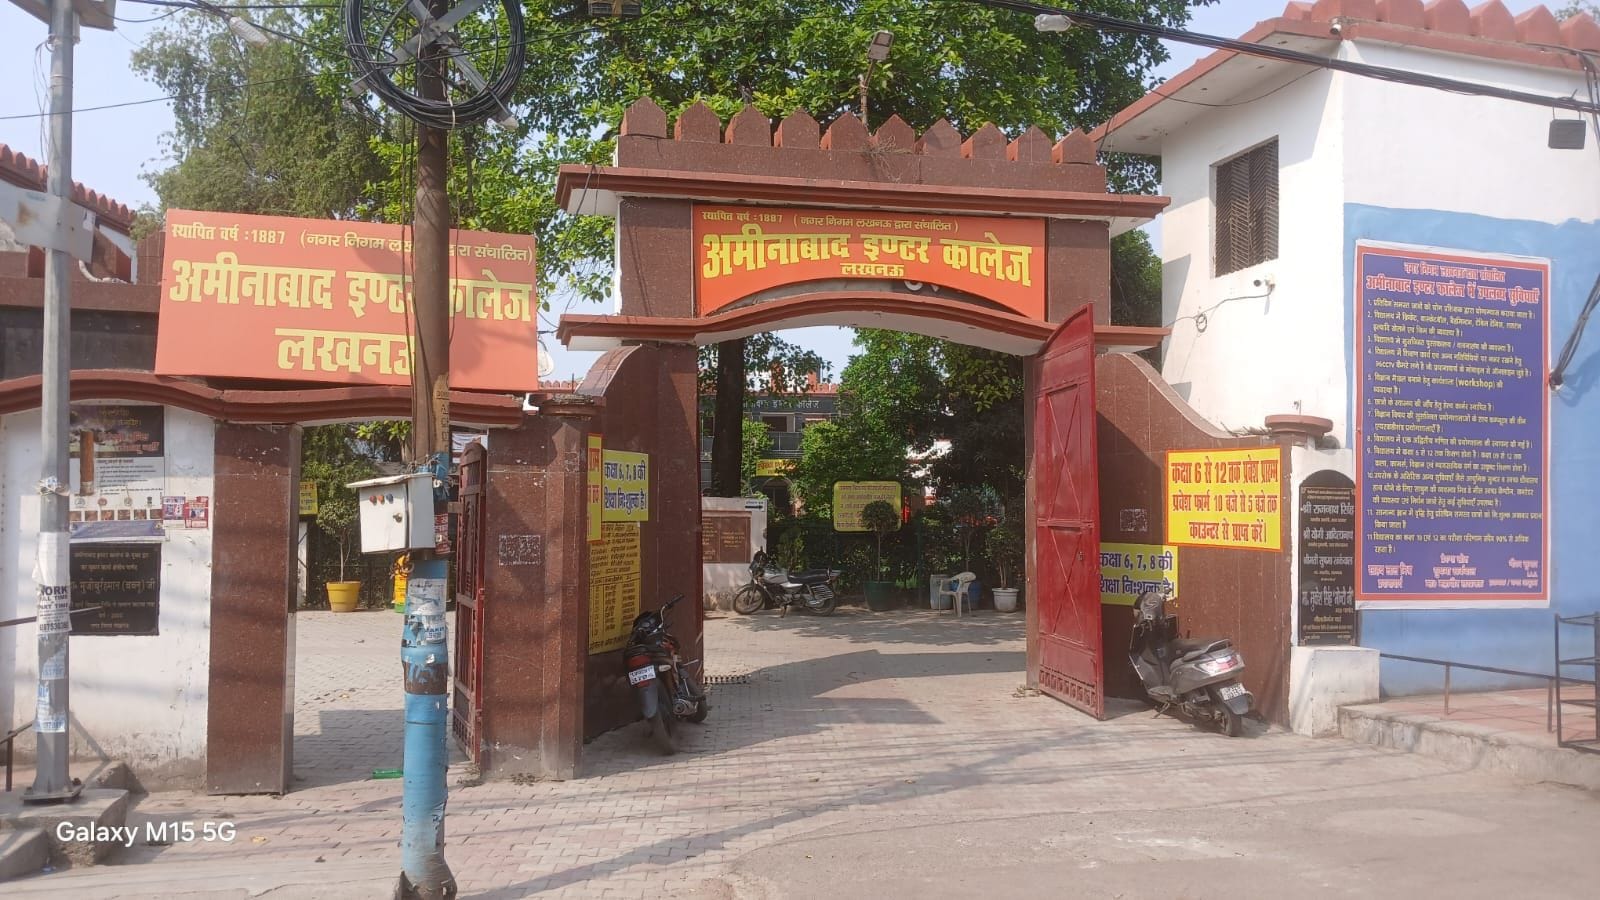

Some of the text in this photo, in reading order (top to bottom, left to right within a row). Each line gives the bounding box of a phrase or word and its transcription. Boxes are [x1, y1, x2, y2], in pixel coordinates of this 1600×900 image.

[702, 210, 732, 222] स्थापित
[736, 211, 750, 223] वर्ष
[826, 214, 854, 227] निगम
[855, 218, 892, 229] लखनऊ
[894, 218, 912, 232] द्वारा
[914, 218, 953, 232] संचालित
[171, 222, 216, 240] स्थापित
[220, 224, 240, 242] वर्ष
[344, 232, 385, 249] निगम
[702, 224, 1032, 286] अमीनाबाद इण्टर कालेज
[840, 262, 904, 277] लखनऊ
[169, 251, 336, 310] अमीनाबाद
[345, 270, 414, 318] इण्ट
[1366, 274, 1411, 292] अमीनाबाद
[1413, 279, 1434, 296] इण्टर
[1467, 282, 1476, 299] में
[1456, 378, 1496, 388] (workshop)
[1171, 462, 1192, 483] कक्षा
[1194, 462, 1201, 483] 6
[1204, 456, 1212, 483] से
[1215, 462, 1226, 483] 12
[1228, 461, 1241, 483] तक
[1242, 454, 1259, 483] प्रवेश
[1172, 490, 1192, 512] प्रवेश
[1194, 490, 1210, 512] फार्म
[1214, 495, 1222, 512] 10
[1225, 490, 1238, 512] बजे
[1240, 490, 1246, 512] से
[1255, 490, 1266, 512] बजे
[1267, 494, 1278, 512] तक
[1302, 502, 1312, 514] श्री
[1314, 504, 1338, 514] राजनाथ
[1189, 521, 1219, 540] काउन्टर
[1222, 518, 1230, 540] से
[1232, 523, 1248, 542] प्राप्त
[1100, 552, 1122, 568] कक्षा
[1158, 550, 1172, 570] की
